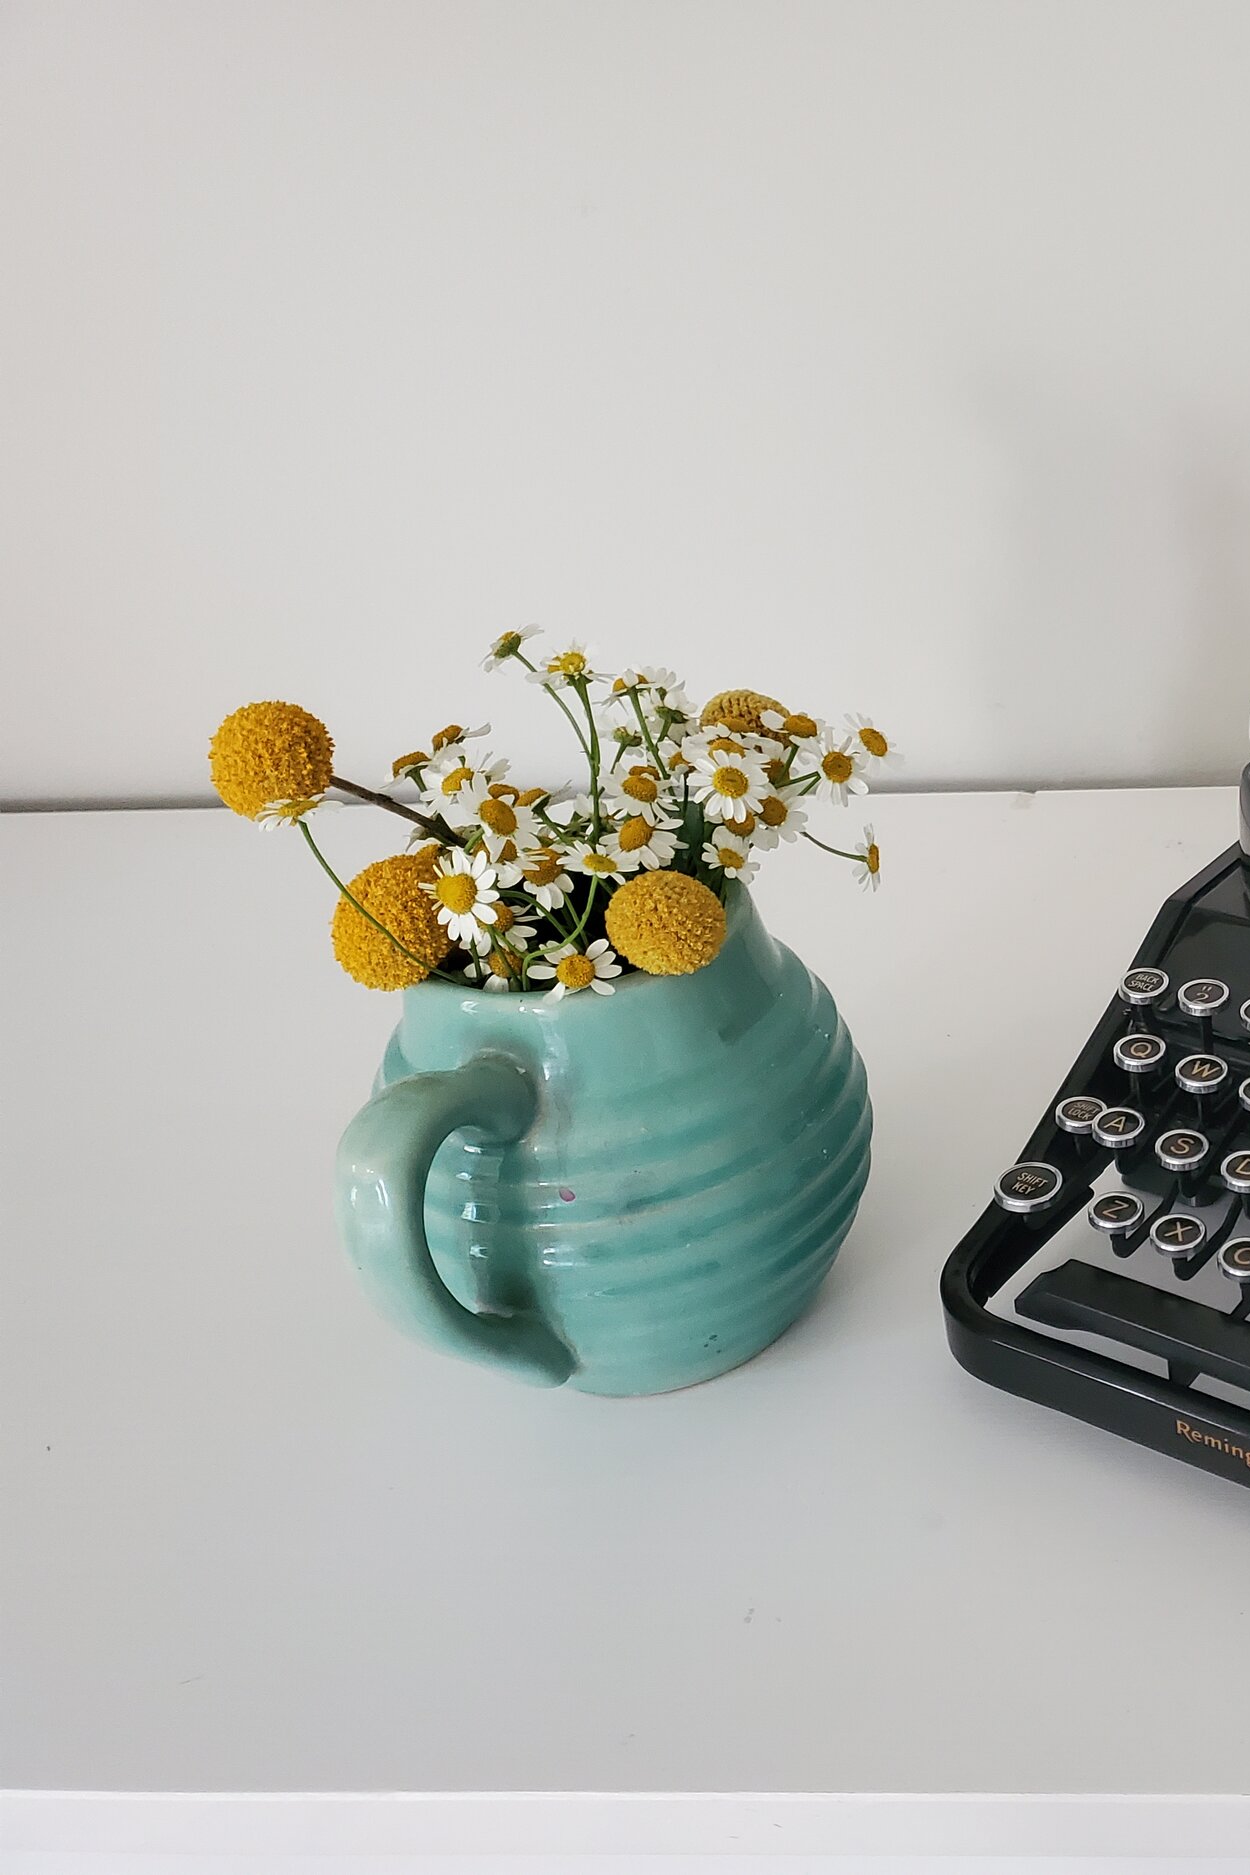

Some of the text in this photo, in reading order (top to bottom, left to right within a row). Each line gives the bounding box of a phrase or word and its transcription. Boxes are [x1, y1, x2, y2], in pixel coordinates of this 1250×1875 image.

[1128, 980, 1155, 992] SPACE
[1135, 973, 1161, 985] BACK
[1193, 992, 1210, 1003] 2
[1130, 1041, 1152, 1058] Q
[1191, 1060, 1221, 1078] W
[1067, 1108, 1092, 1120] LOCK
[1074, 1102, 1099, 1114] SHIFT
[1103, 1116, 1126, 1132] A
[1170, 1137, 1195, 1154] S
[1016, 1171, 1049, 1188] SHIFT
[1011, 1181, 1036, 1195] KEY
[1102, 1200, 1130, 1219] Z
[1164, 1221, 1193, 1242] X
